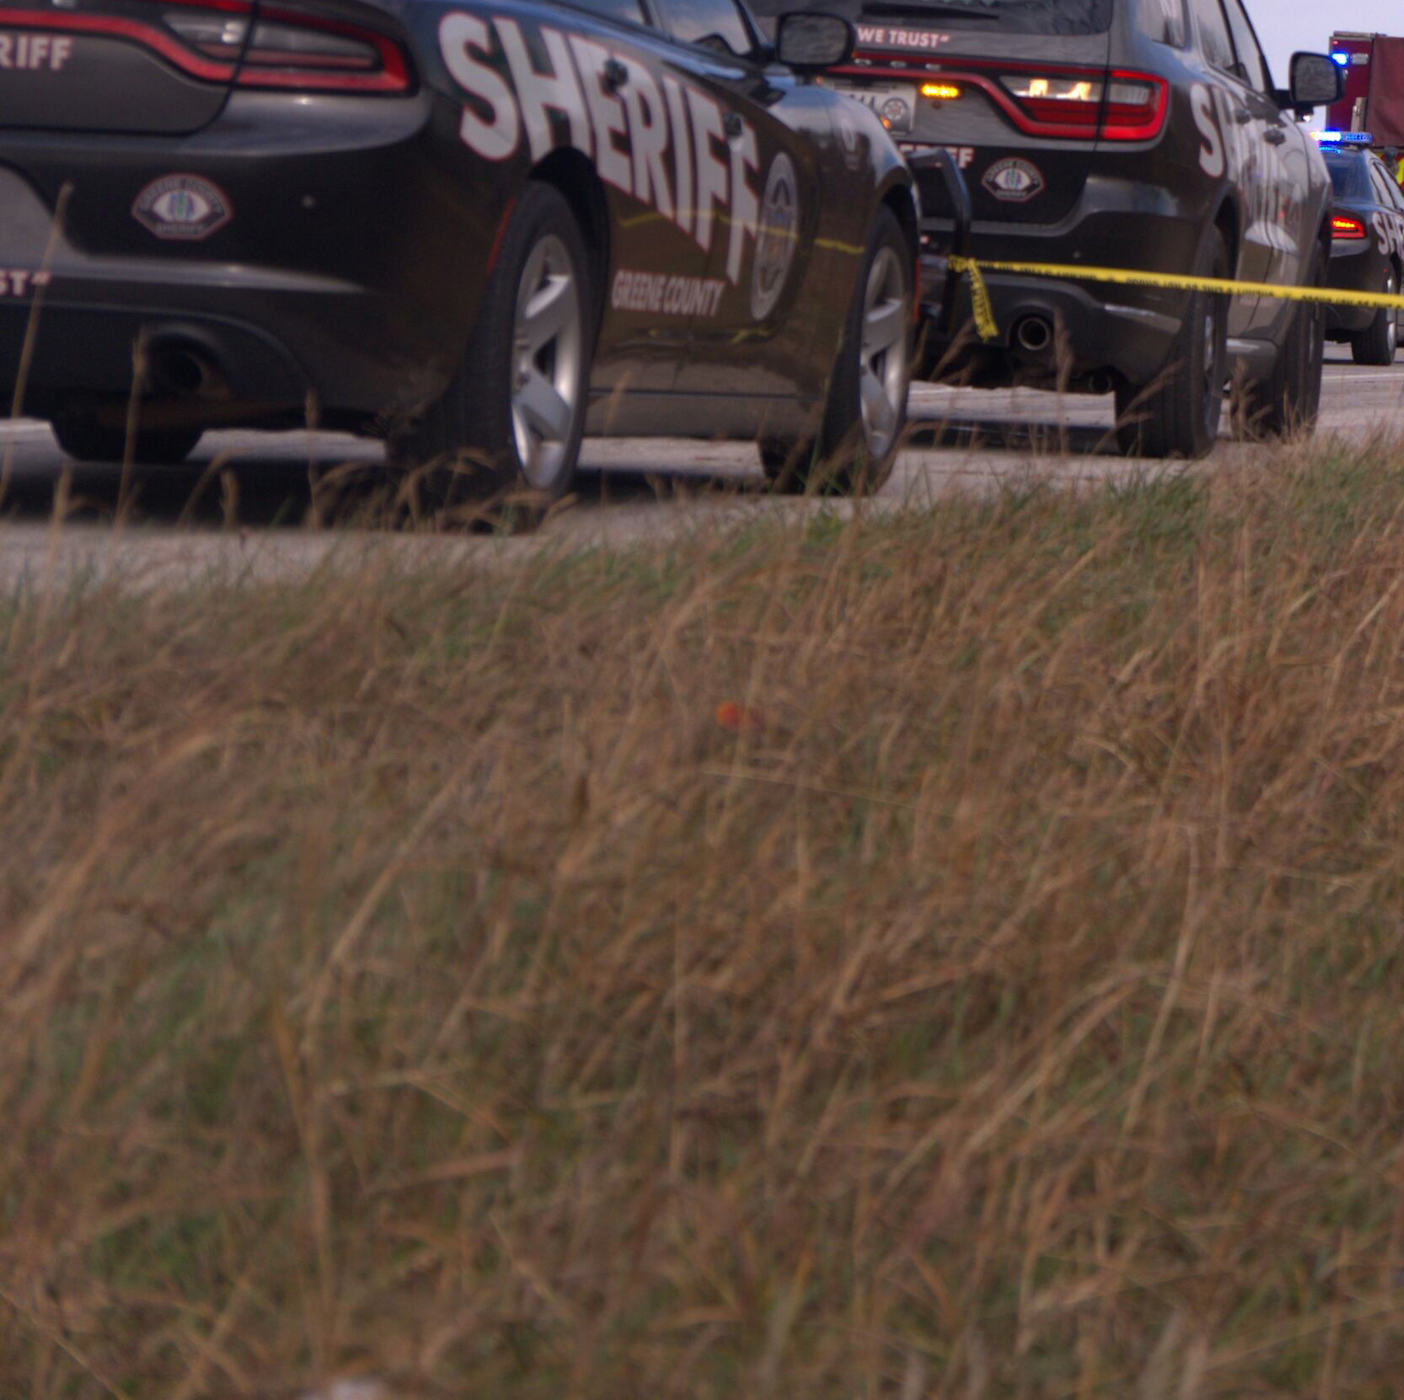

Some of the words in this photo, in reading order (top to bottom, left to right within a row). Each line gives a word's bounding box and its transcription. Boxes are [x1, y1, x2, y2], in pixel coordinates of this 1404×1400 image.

[857, 26, 884, 43] WE
[438, 10, 760, 287] SHERIFF
[612, 269, 666, 311] GREENE
[663, 276, 725, 317] COUNTY
